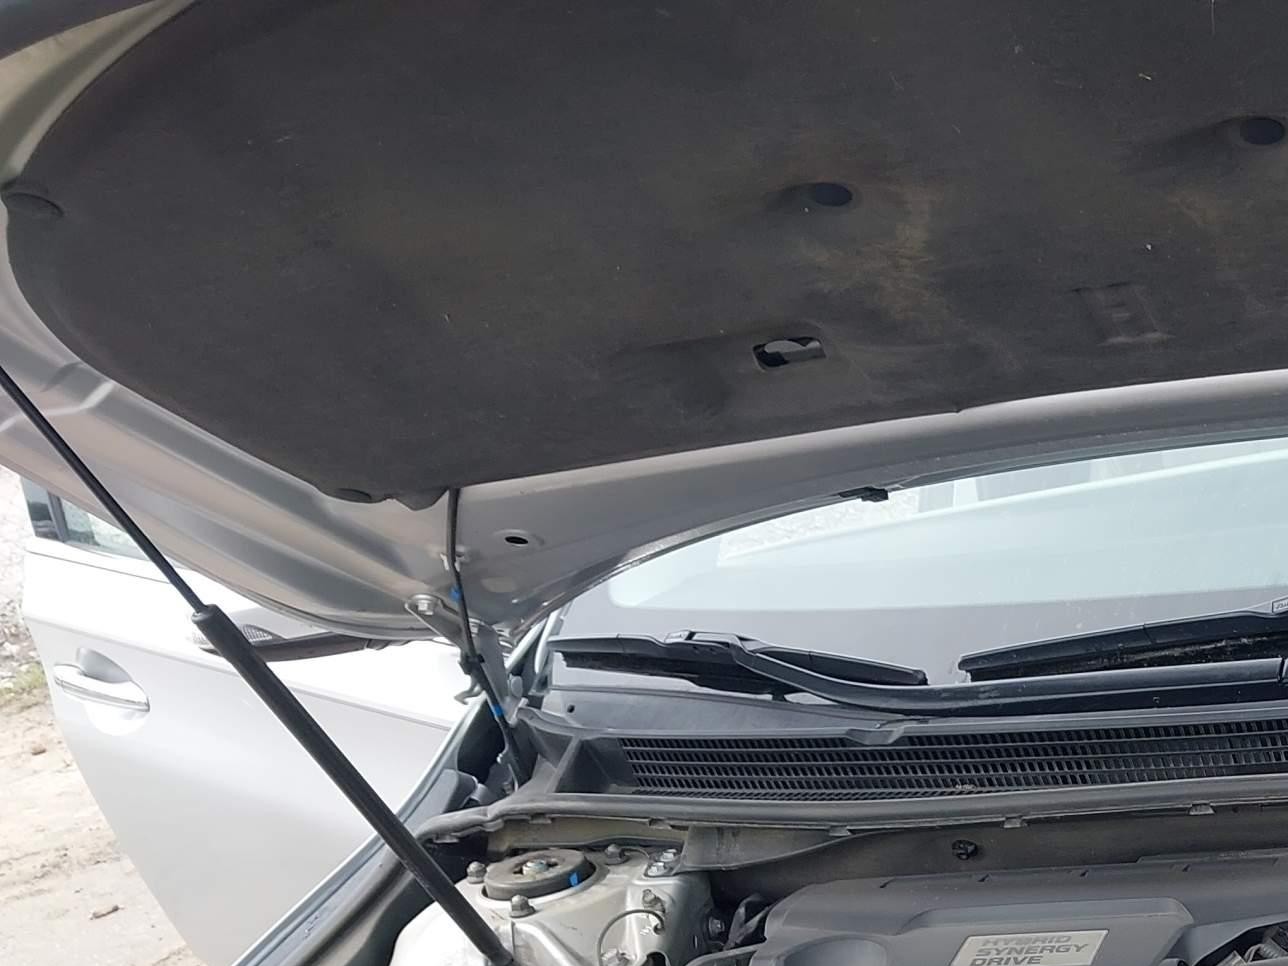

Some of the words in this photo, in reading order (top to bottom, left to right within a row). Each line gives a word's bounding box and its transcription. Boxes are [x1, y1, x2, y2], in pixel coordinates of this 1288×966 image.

[982, 936, 1072, 947] HYBRID
[976, 944, 1087, 956] SYNERGY
[969, 955, 1044, 966] DRIVE
